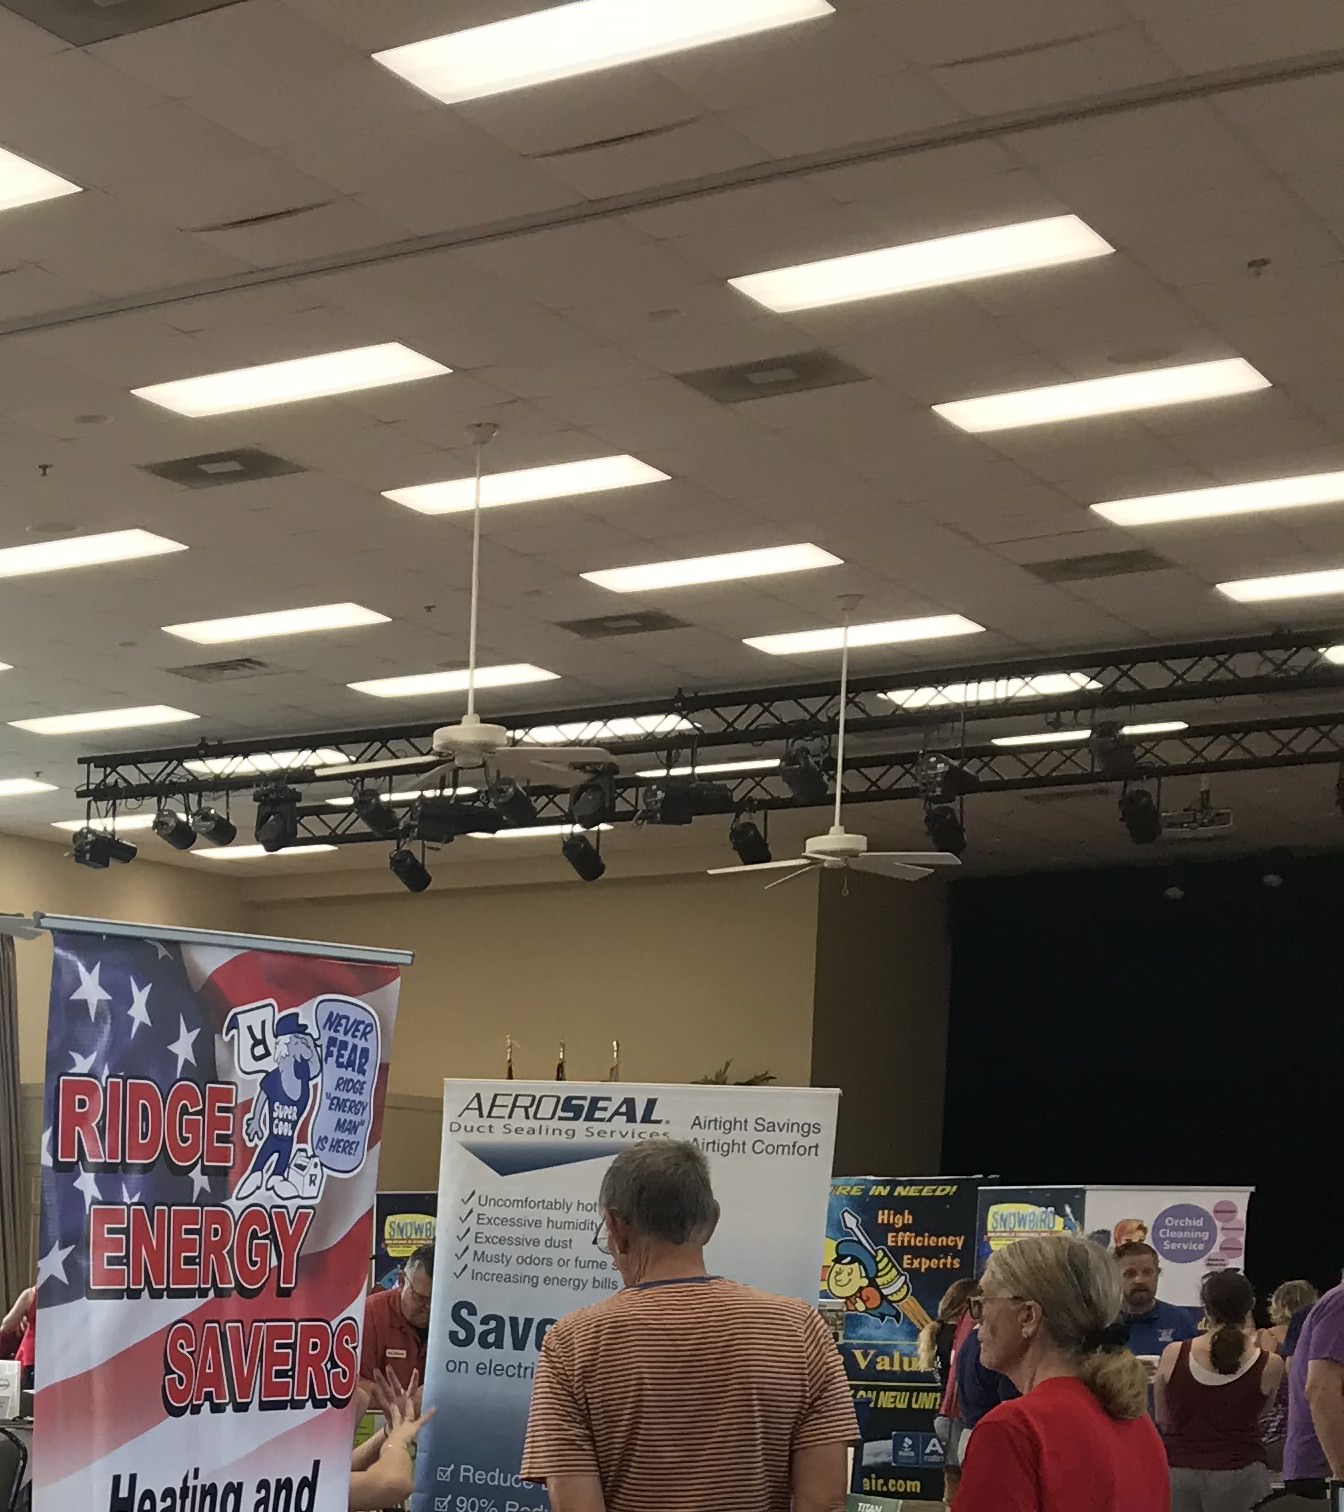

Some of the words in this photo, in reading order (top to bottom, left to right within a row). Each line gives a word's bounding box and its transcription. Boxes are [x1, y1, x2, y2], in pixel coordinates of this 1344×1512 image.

[323, 1010, 374, 1042] NEVER
[324, 1036, 370, 1076] FEAR
[335, 1076, 367, 1095] RIDGE
[273, 1101, 298, 1121] SUPER
[458, 1092, 665, 1124] AEROSEAL
[59, 1076, 237, 1166] RIDGE
[273, 1118, 292, 1136] COOL
[449, 1121, 495, 1134] Duct
[502, 1123, 576, 1140] Sealing
[690, 1115, 748, 1135] Airtight
[753, 1117, 822, 1138] Savings
[315, 1135, 329, 1151] IS
[328, 1137, 360, 1156] HERE!
[752, 1139, 819, 1157] Comfort
[868, 1185, 891, 1196] IN
[893, 1185, 958, 1196] NEED!
[478, 1194, 573, 1214] Uncomfortably
[576, 1199, 597, 1212] hot
[476, 1213, 543, 1229] Excessive
[546, 1216, 600, 1232] humidity
[877, 1209, 913, 1228] High
[992, 1209, 1056, 1231] SNOWBIRD
[1165, 1216, 1204, 1227] Orchid
[474, 1231, 541, 1247] Excessive
[544, 1236, 573, 1249] dust
[887, 1232, 965, 1249] Efficiency
[1158, 1228, 1210, 1240] Cleaning
[89, 1205, 315, 1290] ENERGY
[1163, 1240, 1205, 1250] Service
[472, 1249, 513, 1267] Musty
[515, 1253, 553, 1267] odors
[557, 1257, 571, 1267] or
[574, 1256, 608, 1270] fume
[902, 1254, 961, 1273] Experts
[471, 1268, 539, 1288] Increasing
[543, 1273, 589, 1291] energy
[592, 1276, 618, 1290] bills
[166, 1318, 360, 1407] SAVERS
[445, 1359, 469, 1374] on
[878, 1391, 911, 1409] NEW
